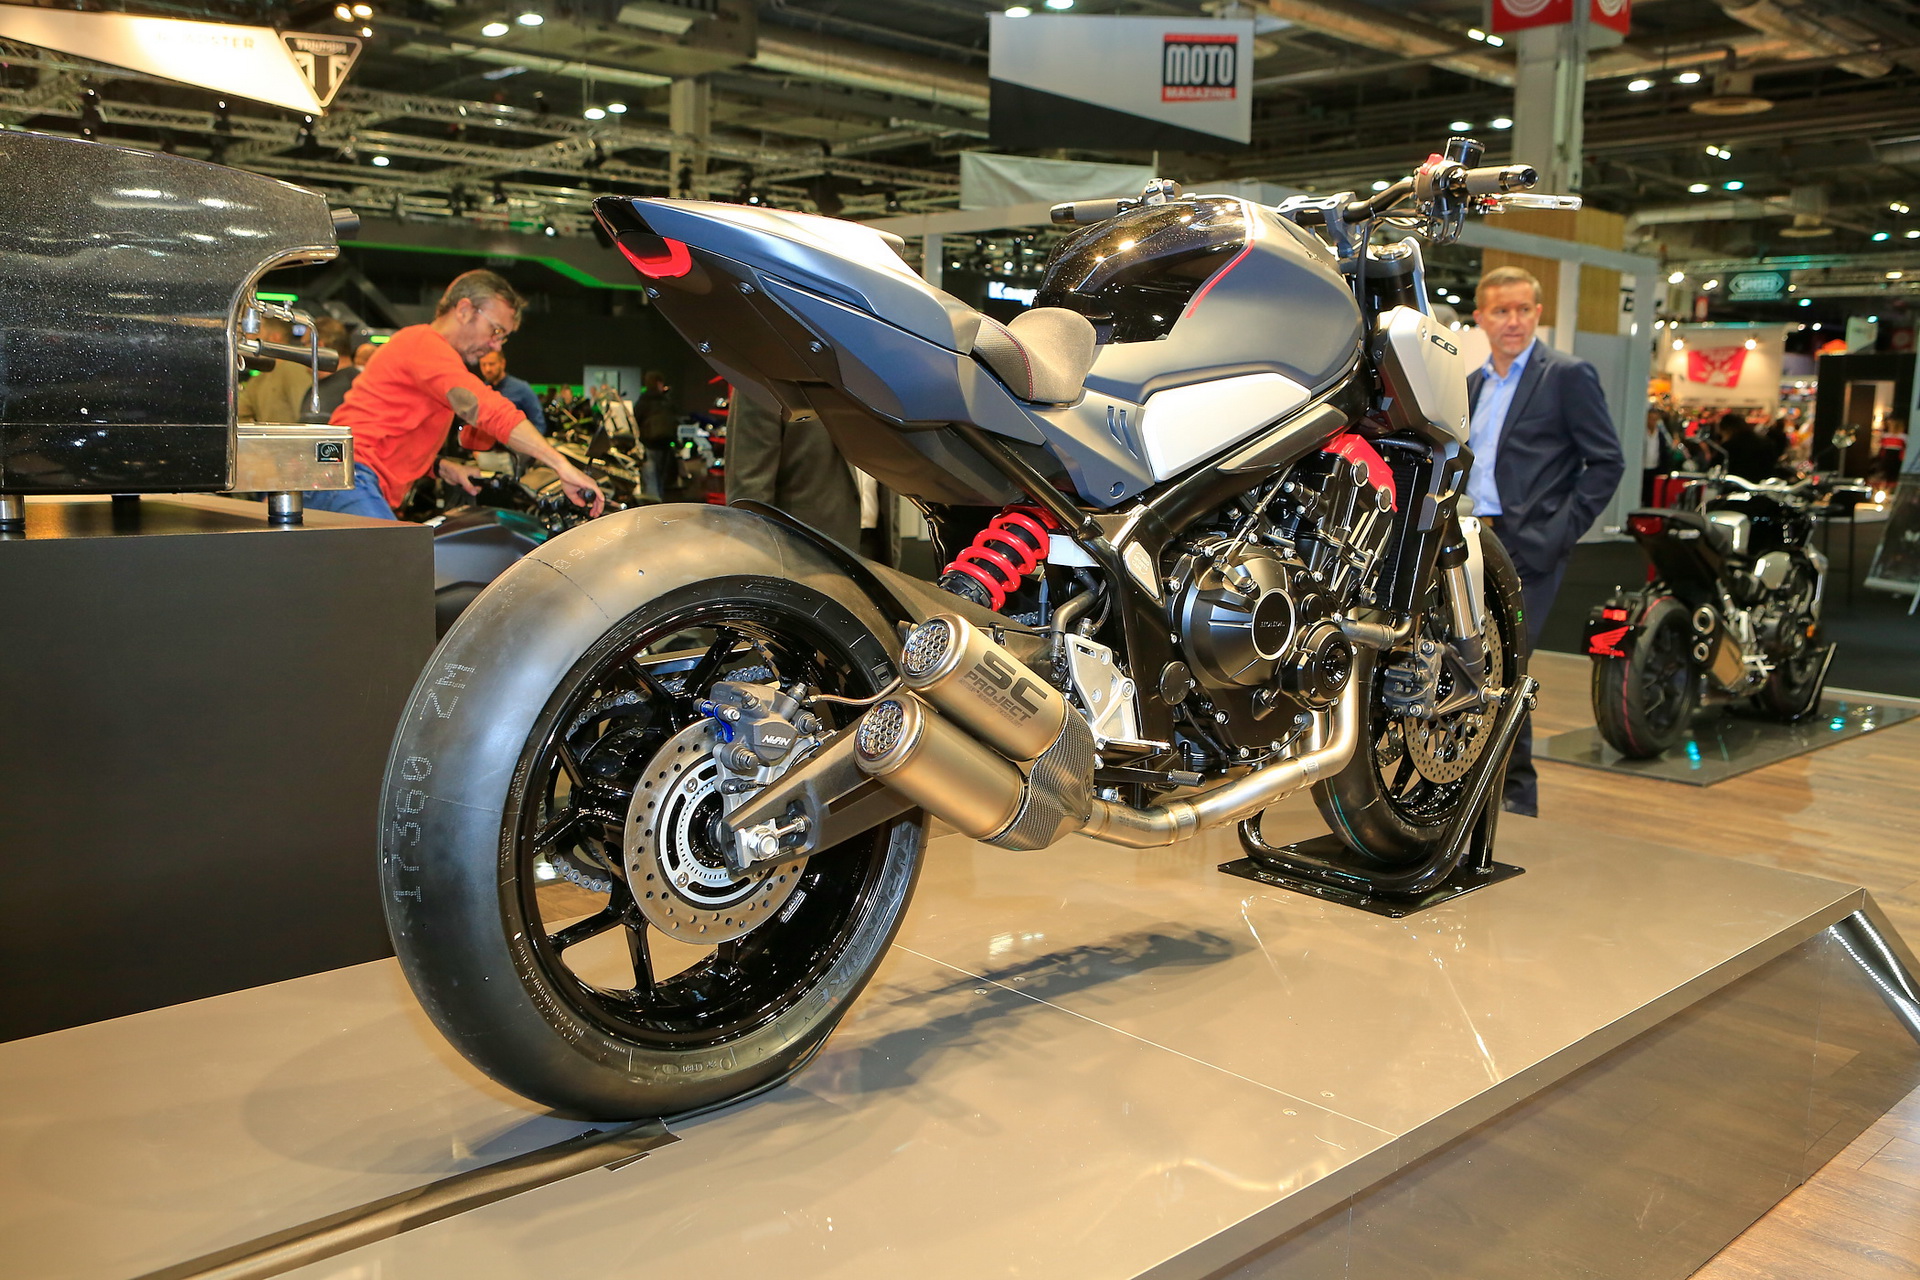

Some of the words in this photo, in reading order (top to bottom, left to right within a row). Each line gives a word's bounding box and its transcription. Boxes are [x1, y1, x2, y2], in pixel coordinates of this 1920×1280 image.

[1166, 43, 1235, 86] MOTO
[1165, 86, 1232, 98] MAGAZINE
[962, 670, 1033, 722] PROJECT
[974, 650, 1048, 716] SC
